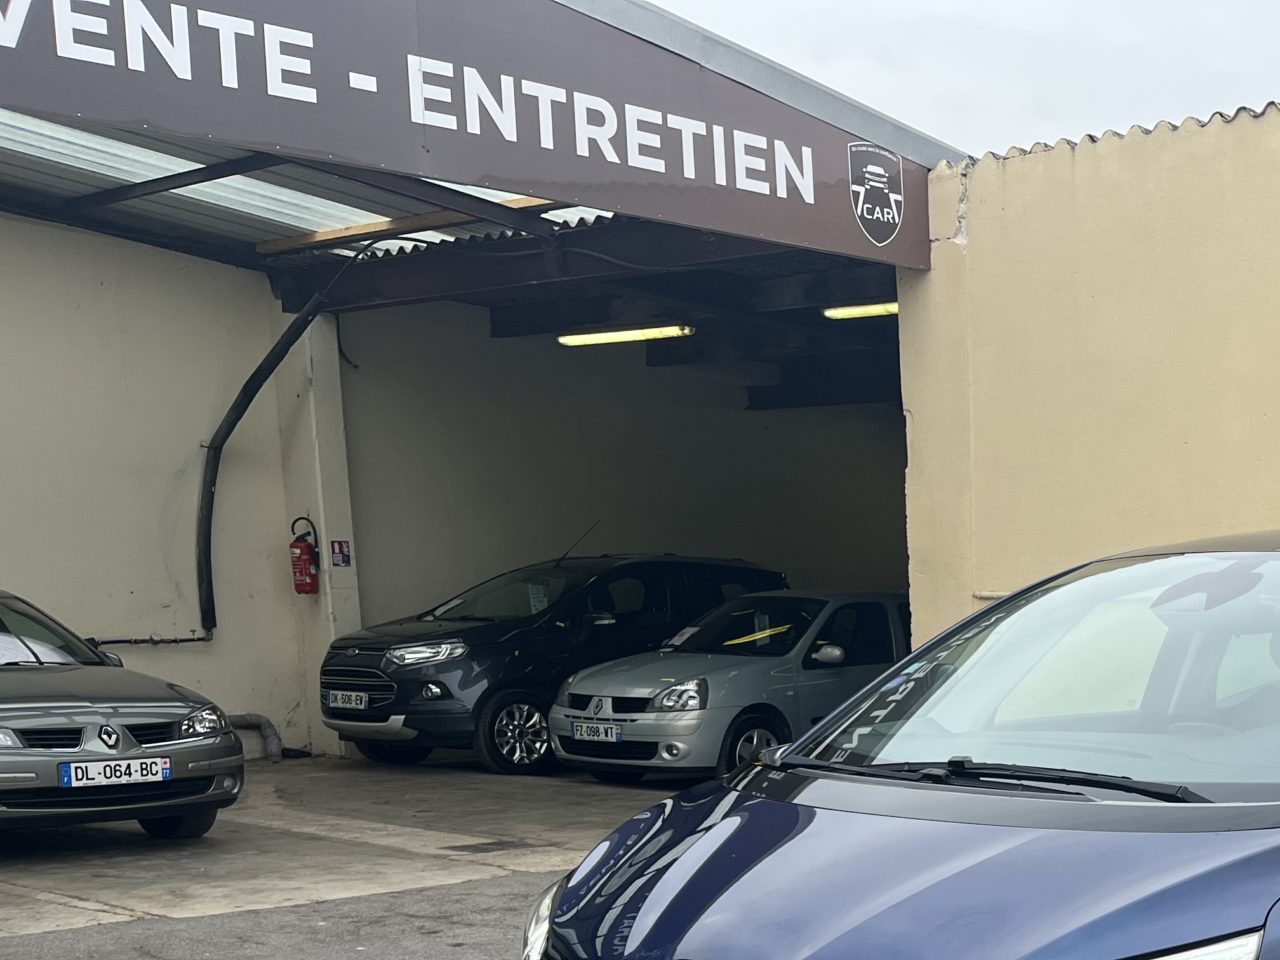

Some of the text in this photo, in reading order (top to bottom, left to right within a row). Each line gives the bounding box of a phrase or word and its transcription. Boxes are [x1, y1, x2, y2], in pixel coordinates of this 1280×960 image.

[406, 53, 815, 205] ENTRETIEN
[575, 725, 614, 739] FZ-098-WT
[74, 761, 159, 782] DL-064-BC
